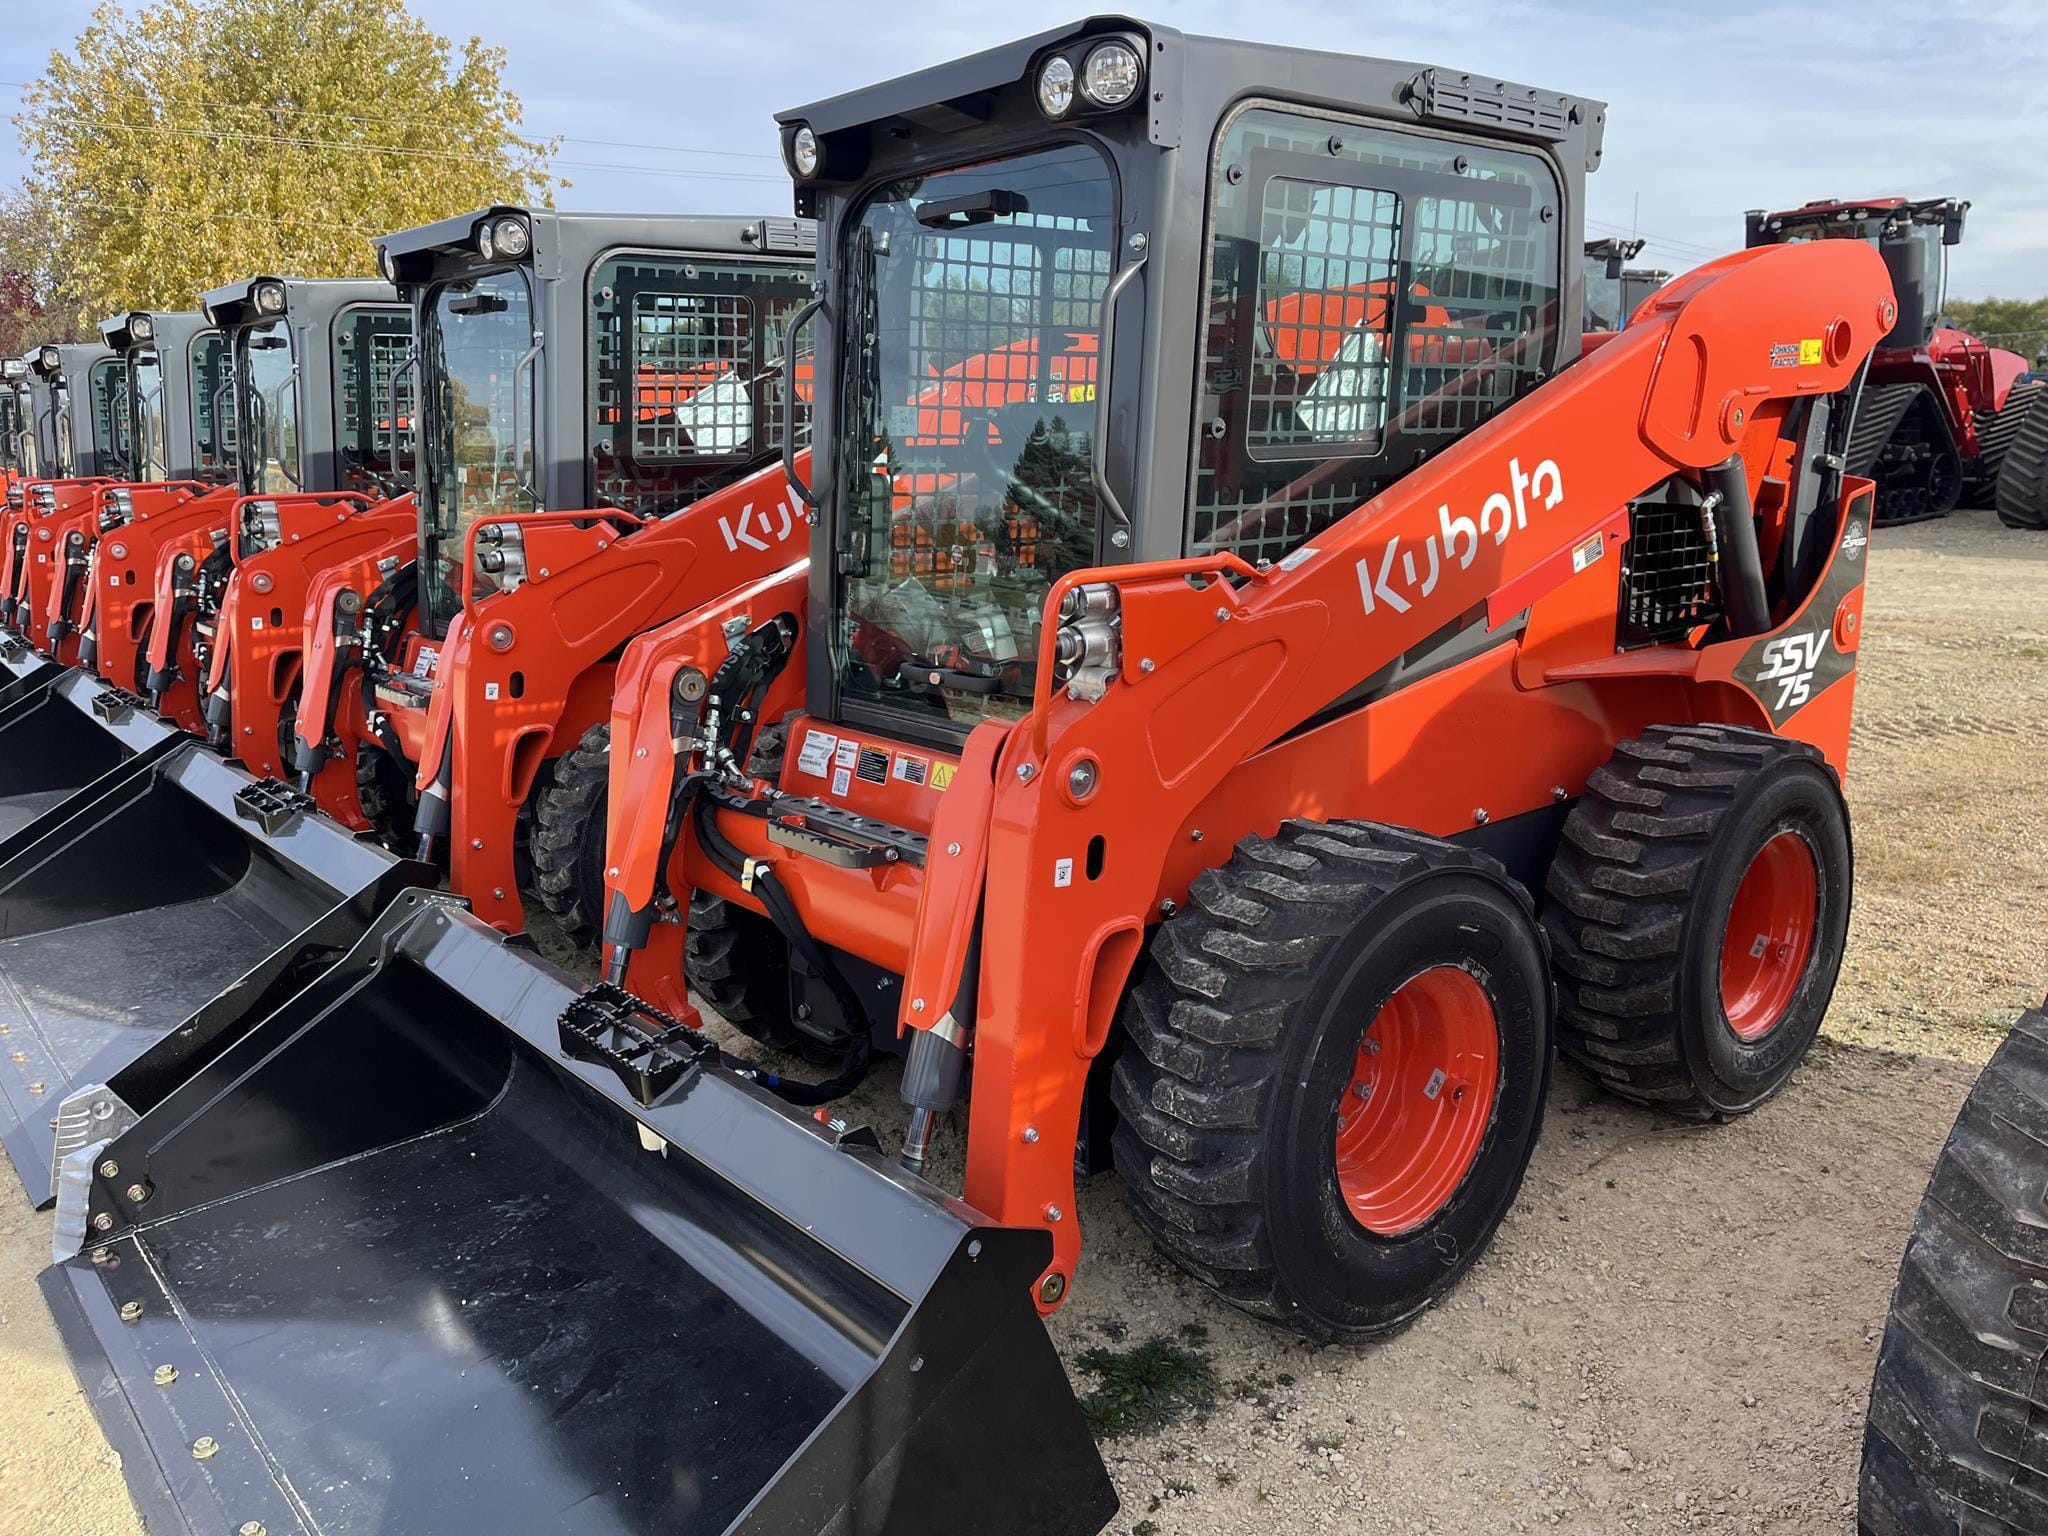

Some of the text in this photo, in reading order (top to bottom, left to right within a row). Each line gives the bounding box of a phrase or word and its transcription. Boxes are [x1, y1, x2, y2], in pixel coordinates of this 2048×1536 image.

[1769, 343, 1799, 355] JOHNSON
[1769, 356, 1798, 368] TRACTOR
[1355, 457, 1564, 616] Kubota
[1755, 629, 1831, 681] SSV
[1774, 672, 1813, 711] 75
